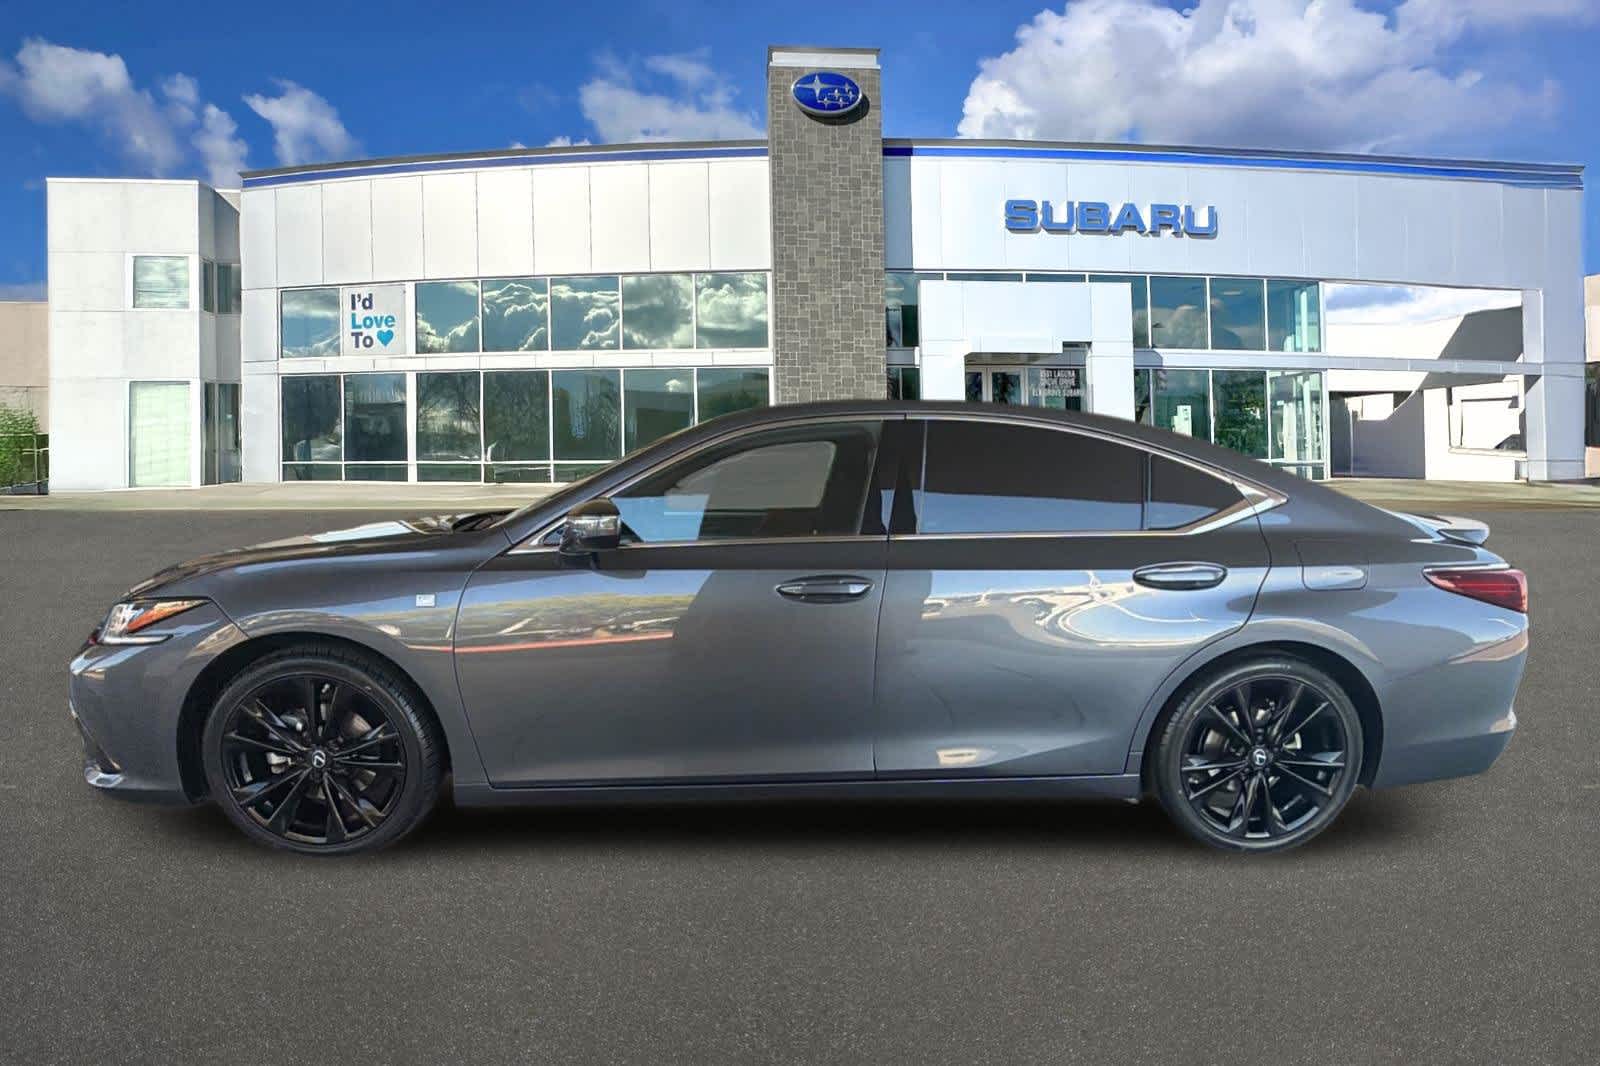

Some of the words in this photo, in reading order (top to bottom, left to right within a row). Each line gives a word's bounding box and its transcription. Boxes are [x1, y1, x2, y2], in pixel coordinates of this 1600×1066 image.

[1005, 199, 1217, 238] SUBARU
[351, 293, 373, 310] I'd
[351, 313, 396, 329] Love
[351, 332, 374, 348] To
